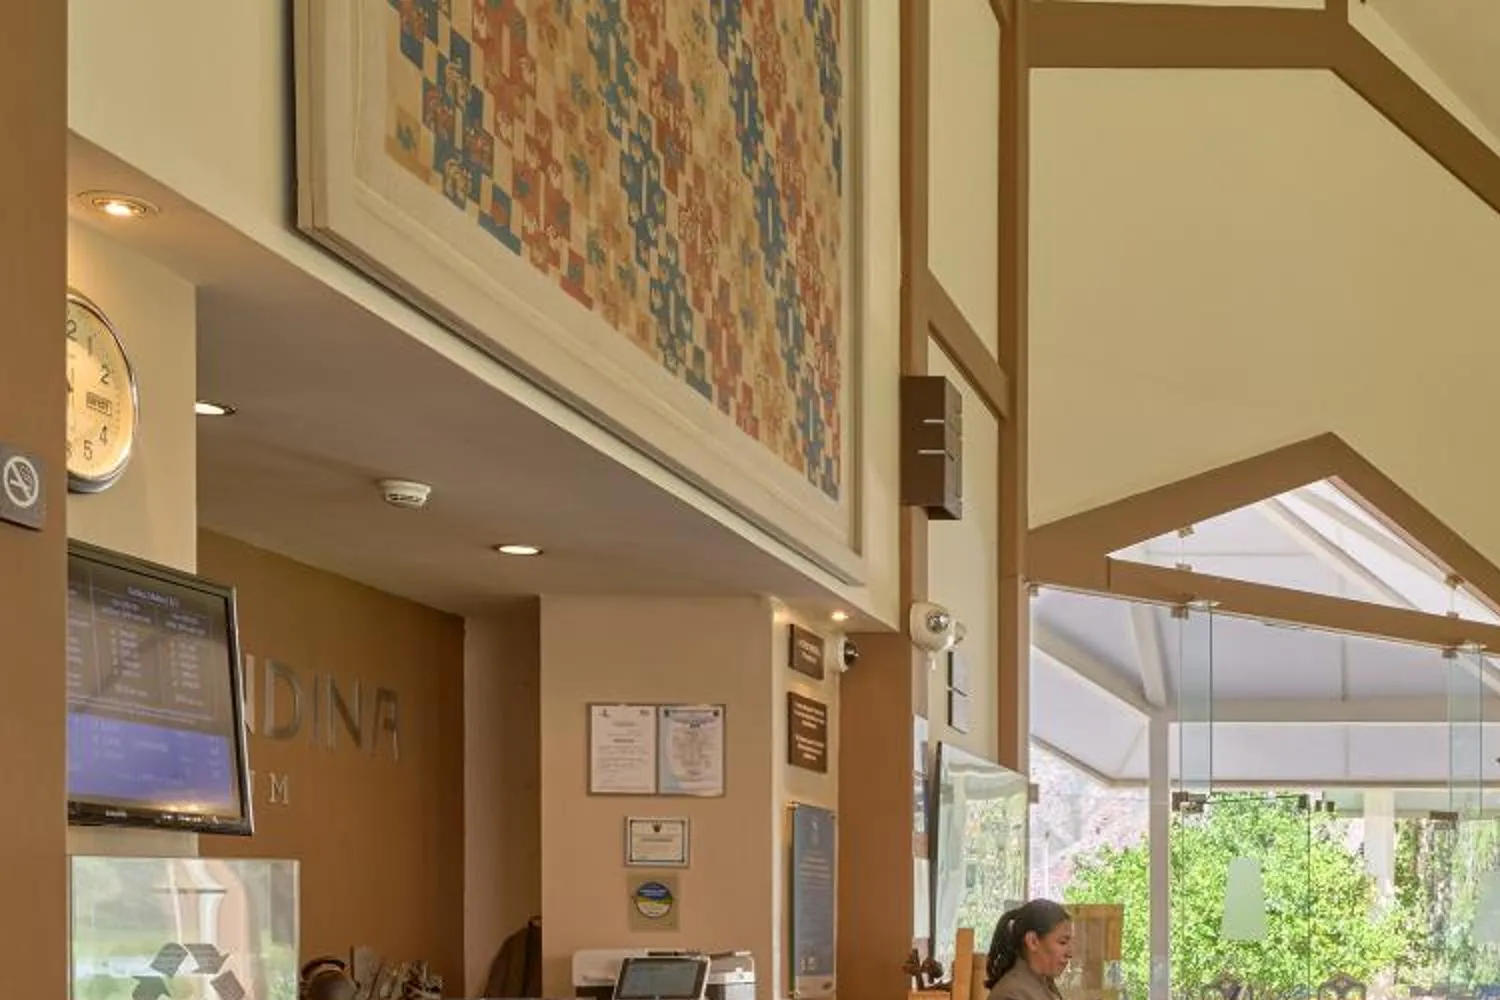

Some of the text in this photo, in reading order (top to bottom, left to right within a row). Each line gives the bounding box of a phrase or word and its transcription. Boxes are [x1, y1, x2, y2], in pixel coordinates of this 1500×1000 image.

[100, 364, 111, 385] 2
[99, 425, 109, 445] 4
[84, 439, 93, 460] 5
